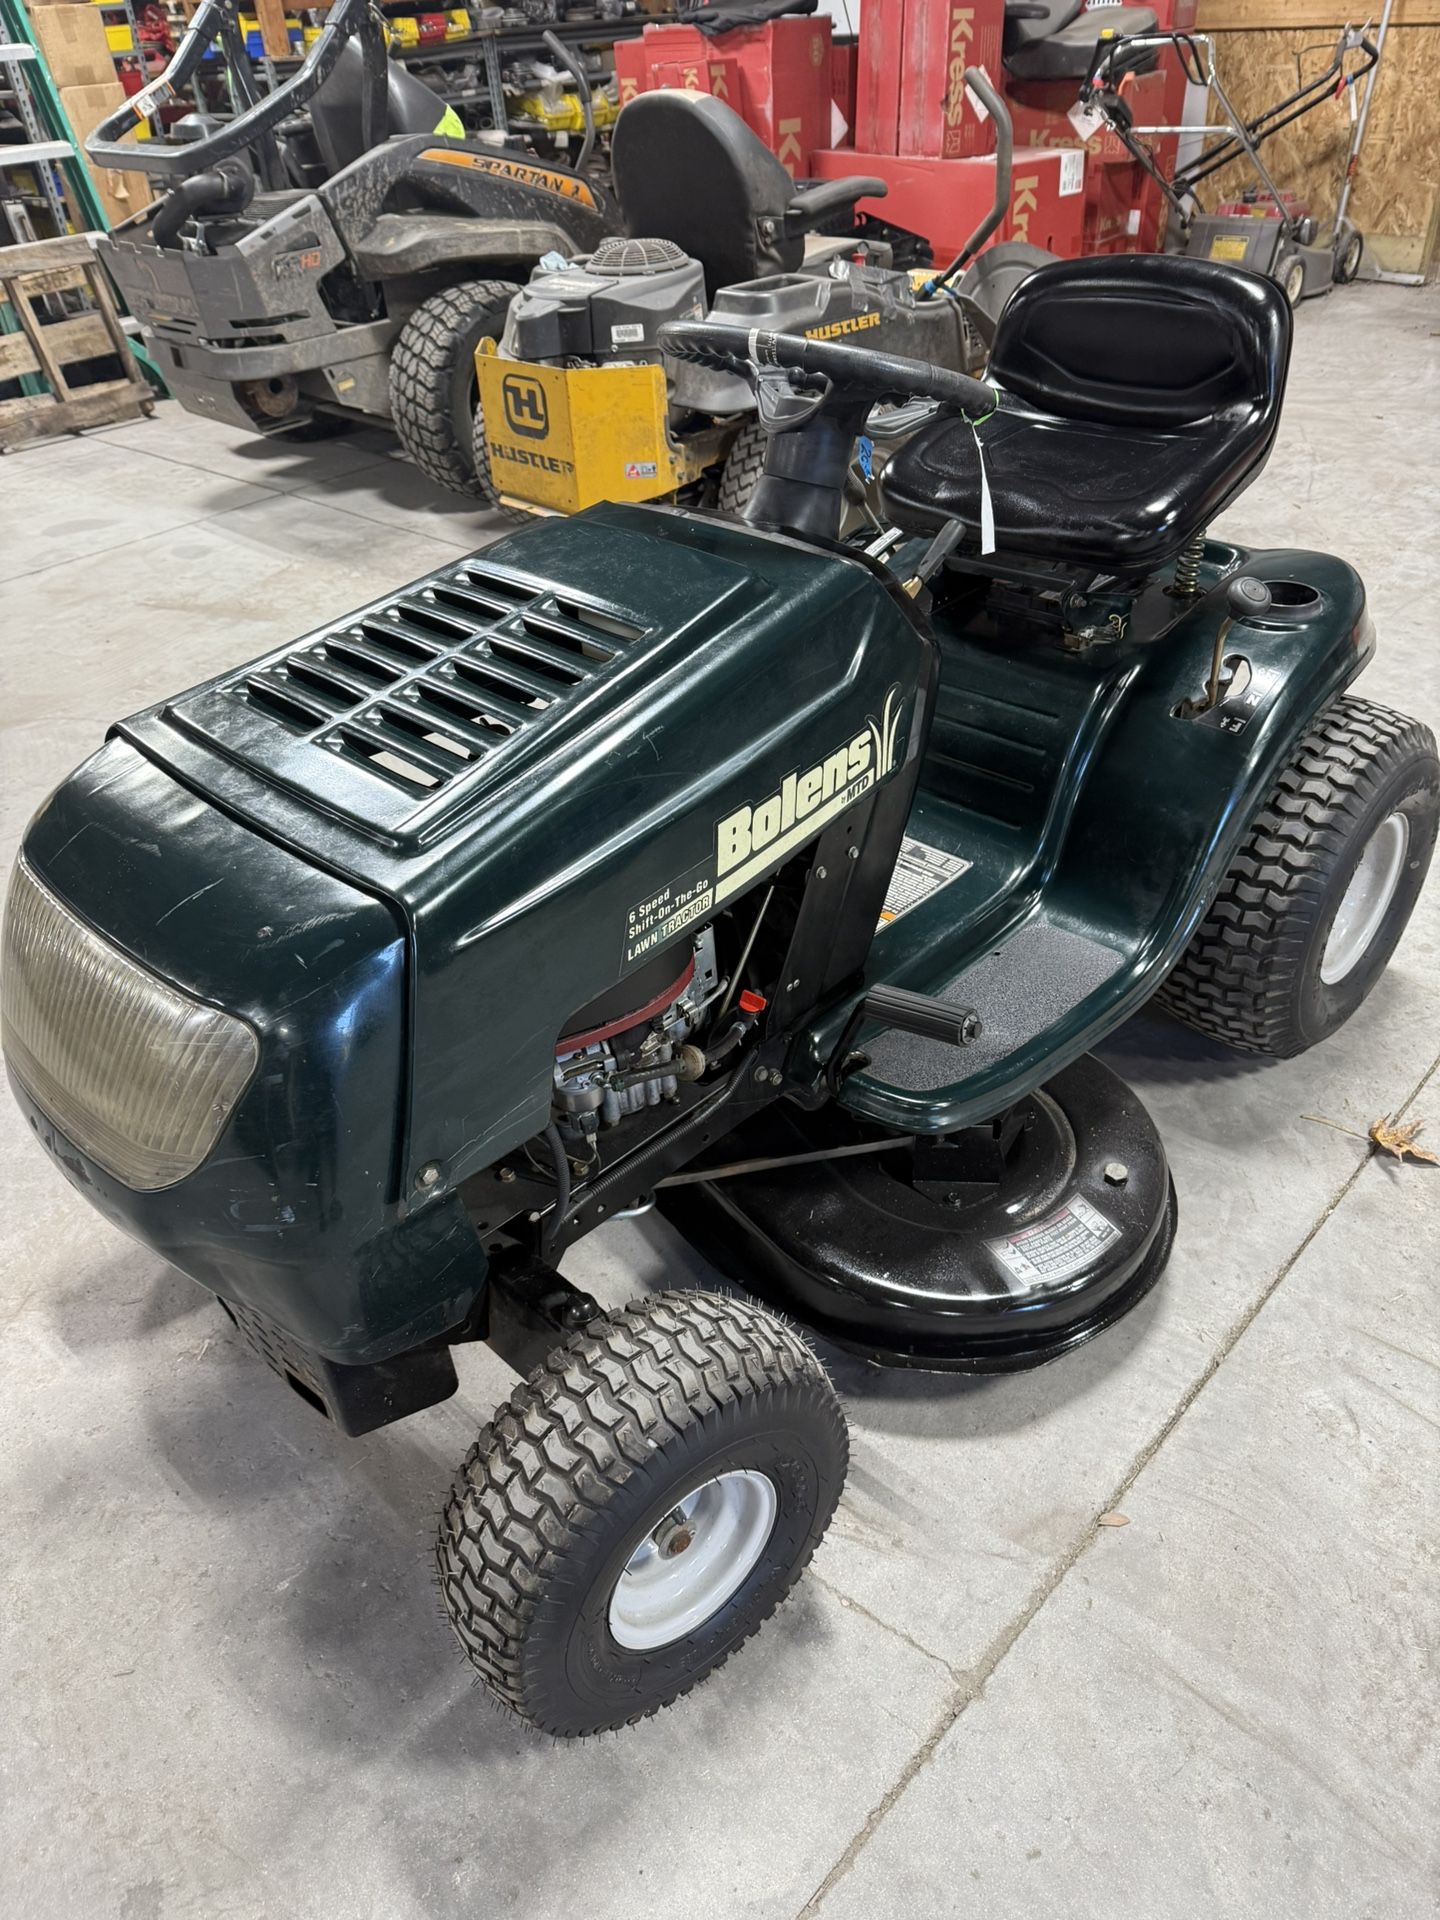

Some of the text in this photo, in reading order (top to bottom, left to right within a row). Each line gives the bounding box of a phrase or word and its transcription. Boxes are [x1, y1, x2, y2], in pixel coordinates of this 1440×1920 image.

[947, 7, 975, 127] Kress
[472, 158, 563, 193] SPARTAN
[805, 311, 881, 341] HUSTLER
[489, 442, 575, 474] HUSTLER
[718, 729, 872, 878] Bolens
[847, 775, 869, 803] MTD
[628, 879, 709, 939] Shift-On-The-Go
[629, 888, 670, 924] 6 Speed
[627, 895, 710, 962] LAWN TRACTOR
